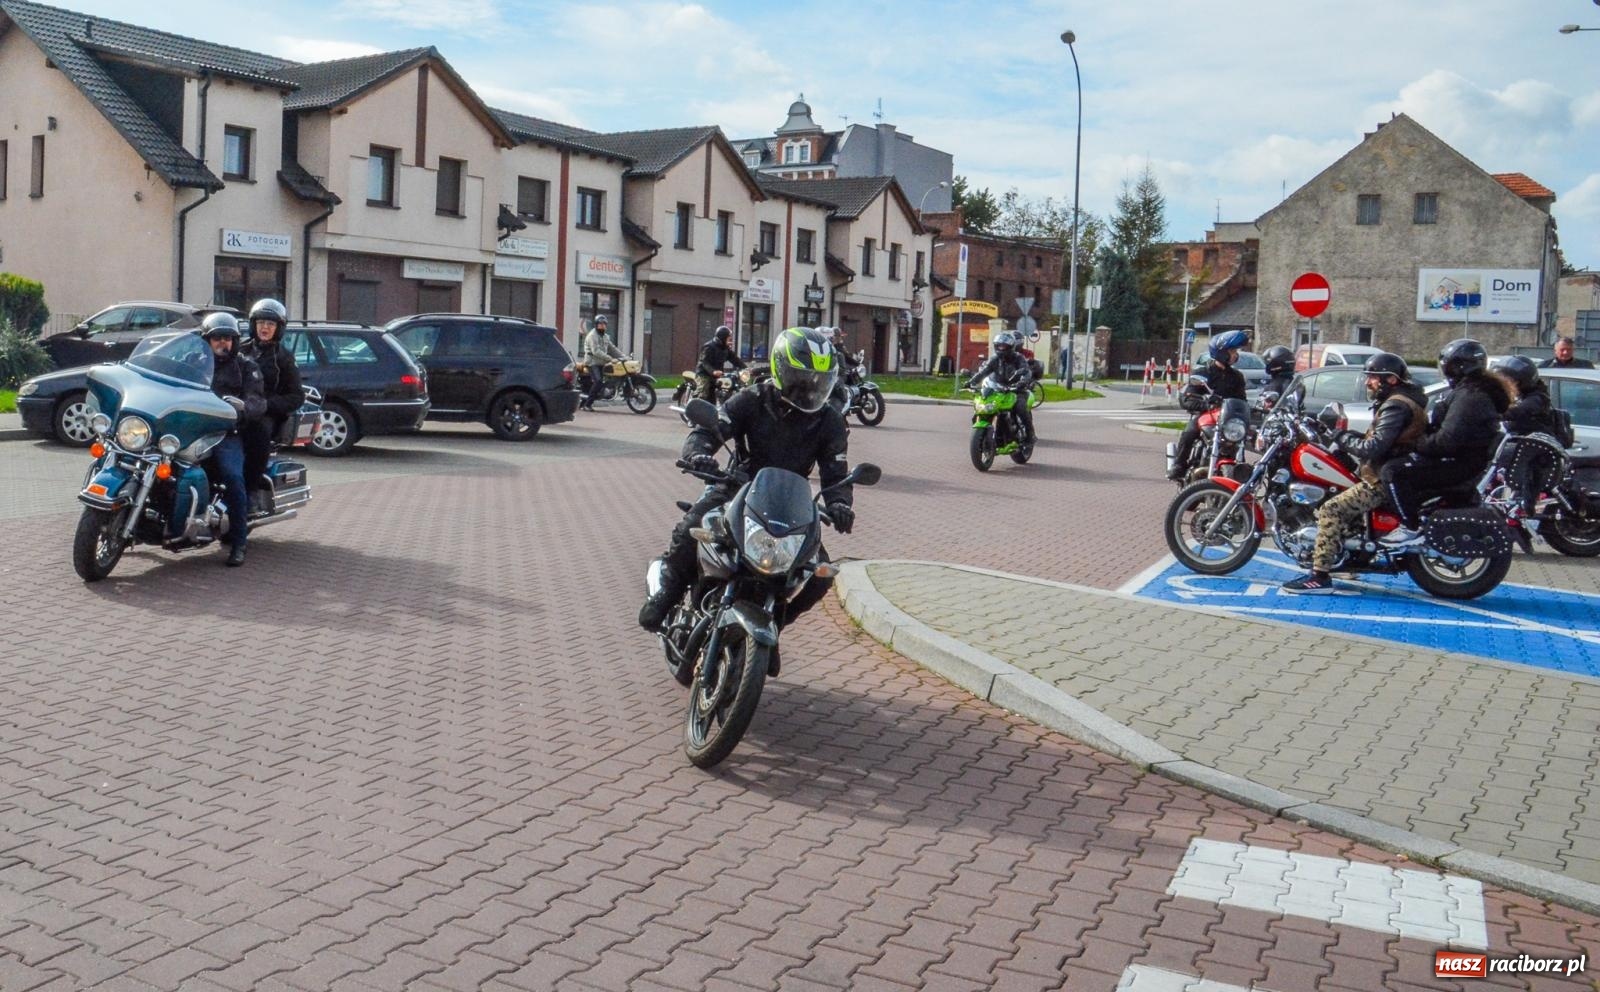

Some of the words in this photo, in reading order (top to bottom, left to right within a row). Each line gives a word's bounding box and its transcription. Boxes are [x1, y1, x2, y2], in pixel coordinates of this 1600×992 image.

[248, 236, 289, 246] FOTOGRAF
[588, 255, 625, 273] dentica
[1492, 279, 1531, 292] Dom
